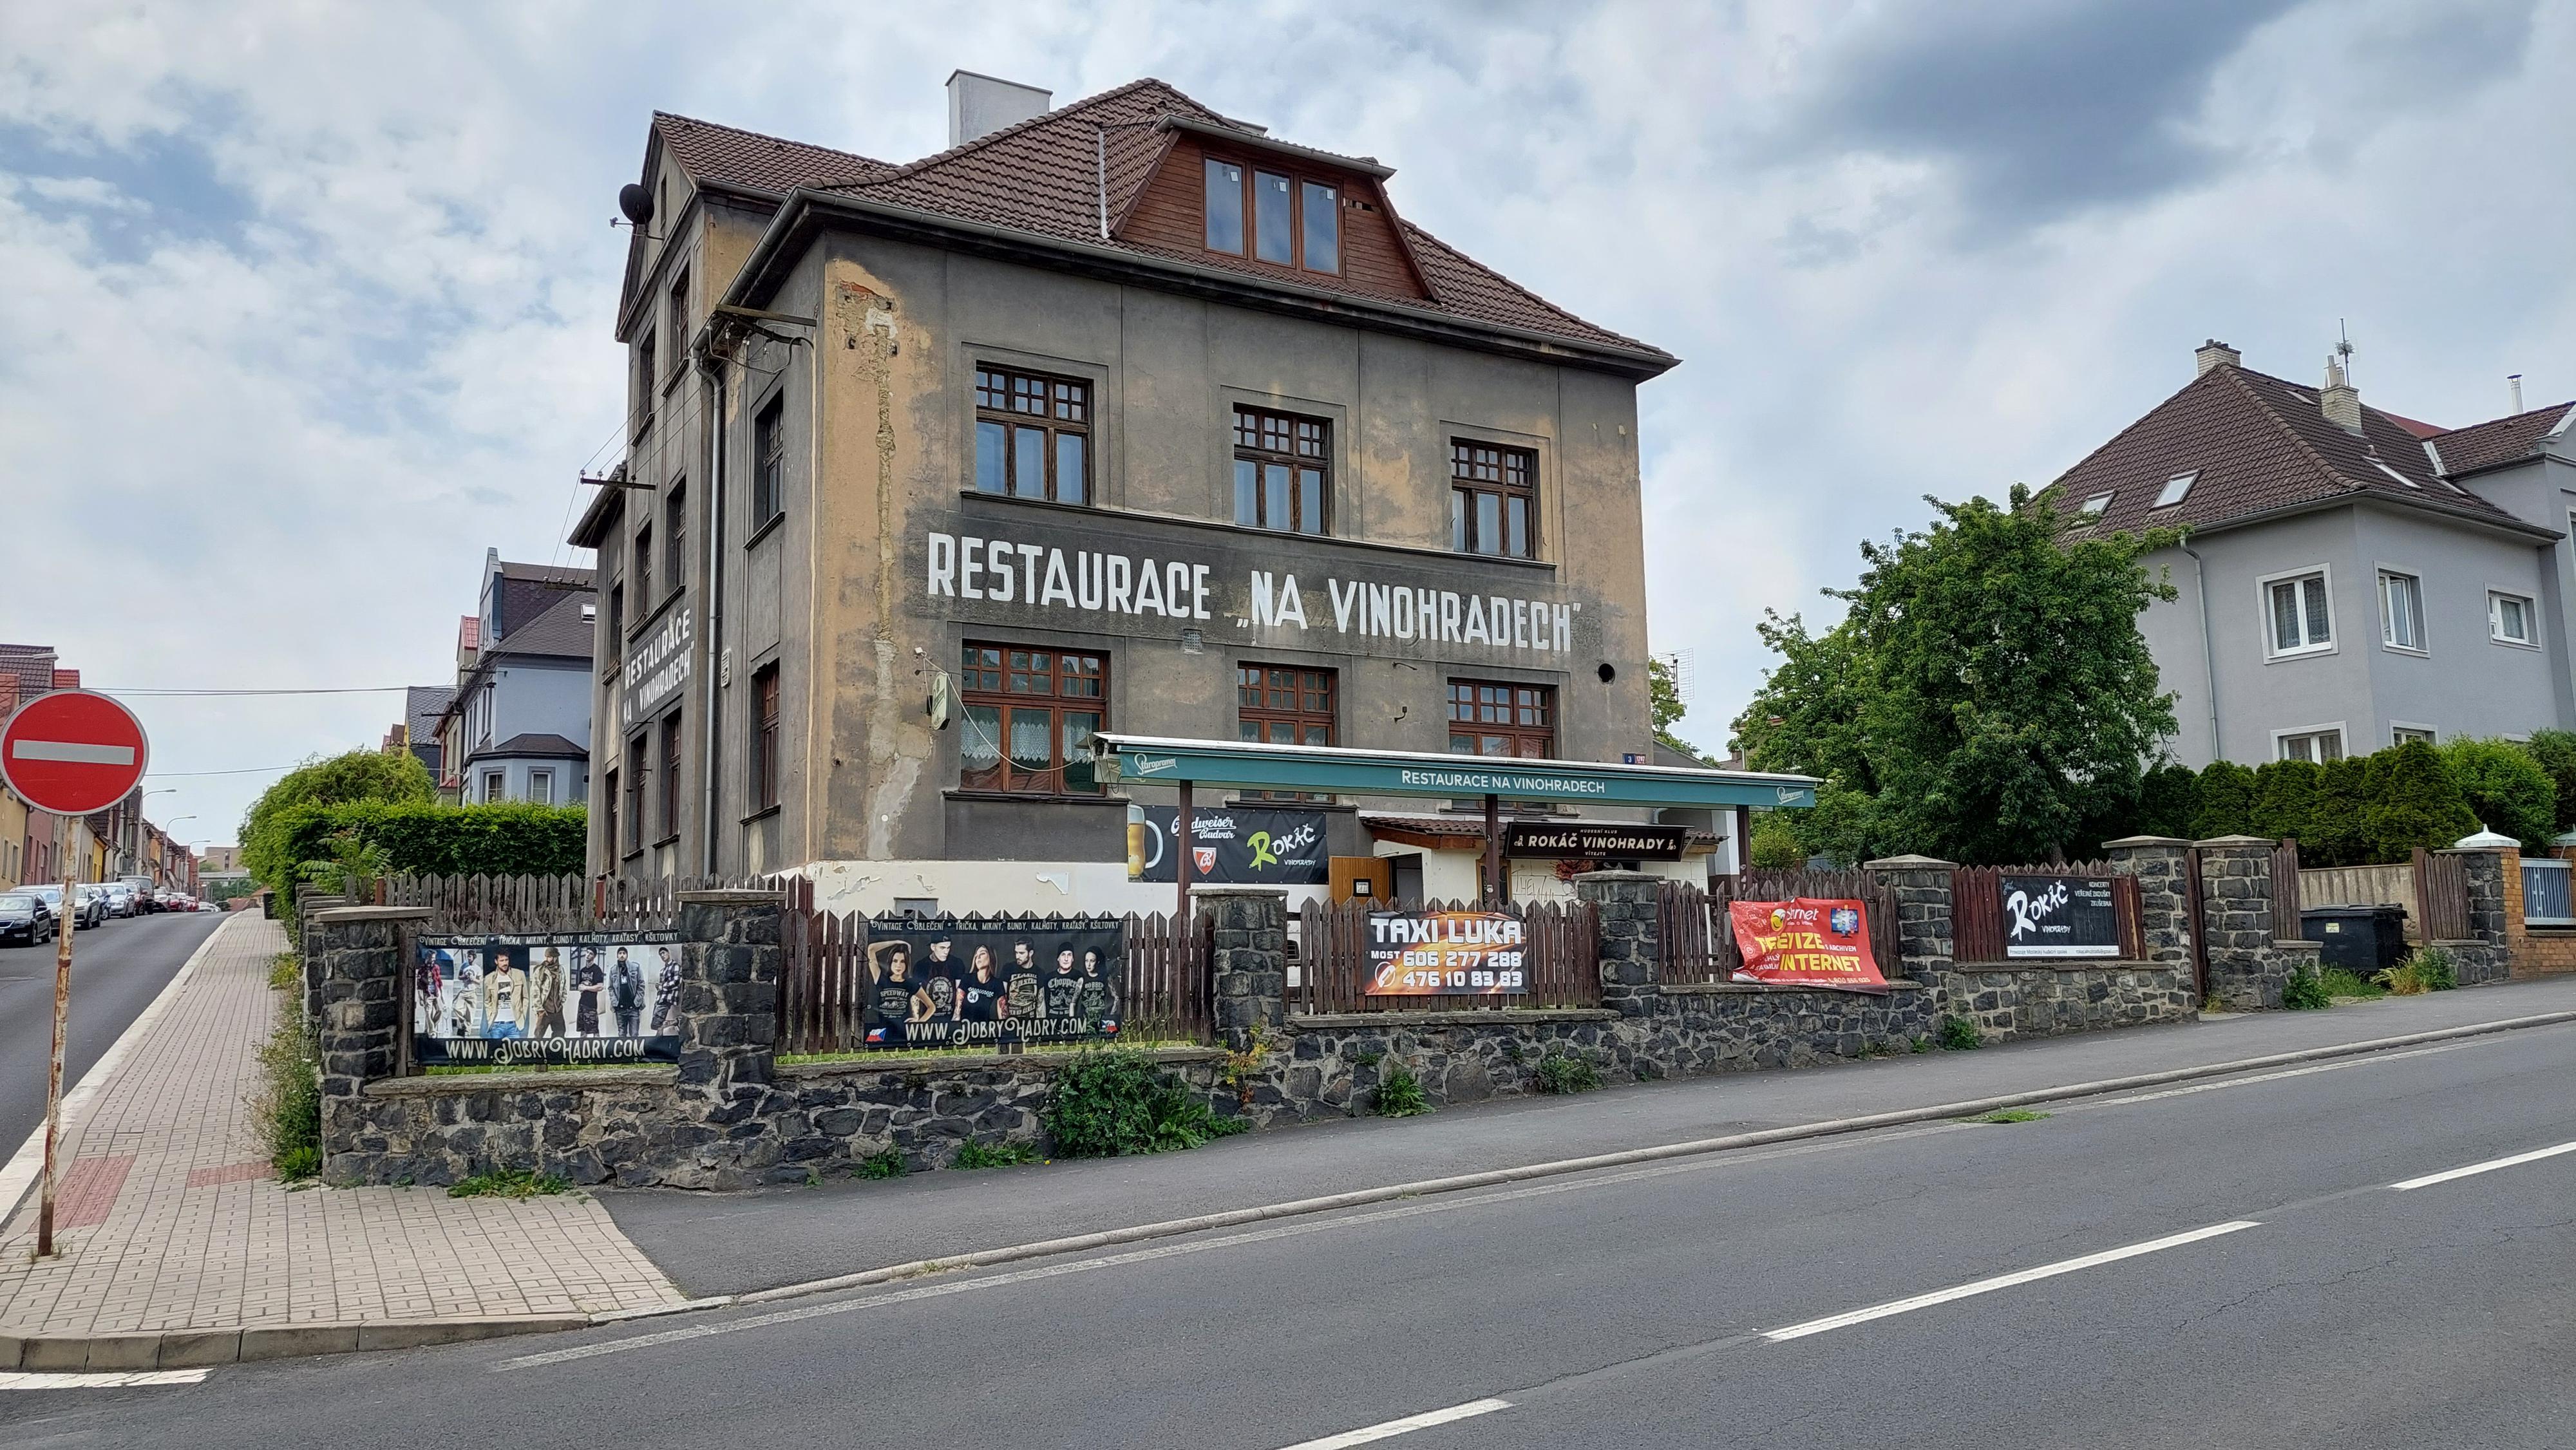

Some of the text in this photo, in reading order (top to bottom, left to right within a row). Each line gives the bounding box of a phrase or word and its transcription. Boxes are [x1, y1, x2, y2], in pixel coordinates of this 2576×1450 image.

[928, 532, 1211, 619] RESTAURACE
[625, 608, 690, 691] RESTAURACE
[1134, 753, 1178, 775] Staropramen
[1401, 769, 1605, 793] RESTAURACE NA VINOHRADECH
[1171, 815, 1236, 836] Bdweiser
[1199, 827, 1236, 840] Budvar
[1528, 833, 1665, 850] ROKÁČ VINOHRADY
[869, 920, 903, 931] VINTAGE
[906, 919, 945, 931] OBLEČENÍ
[1090, 920, 1119, 930] KŠILTOVKY
[1370, 918, 1522, 944] TAXI LUKA
[419, 936, 447, 946] VINTAGE
[645, 932, 678, 943] KŠILTOVKY
[1371, 950, 1522, 967] MOST 606 277 288
[1779, 953, 1862, 972] INTERNET
[1402, 971, 1522, 986] 476 10 83 83
